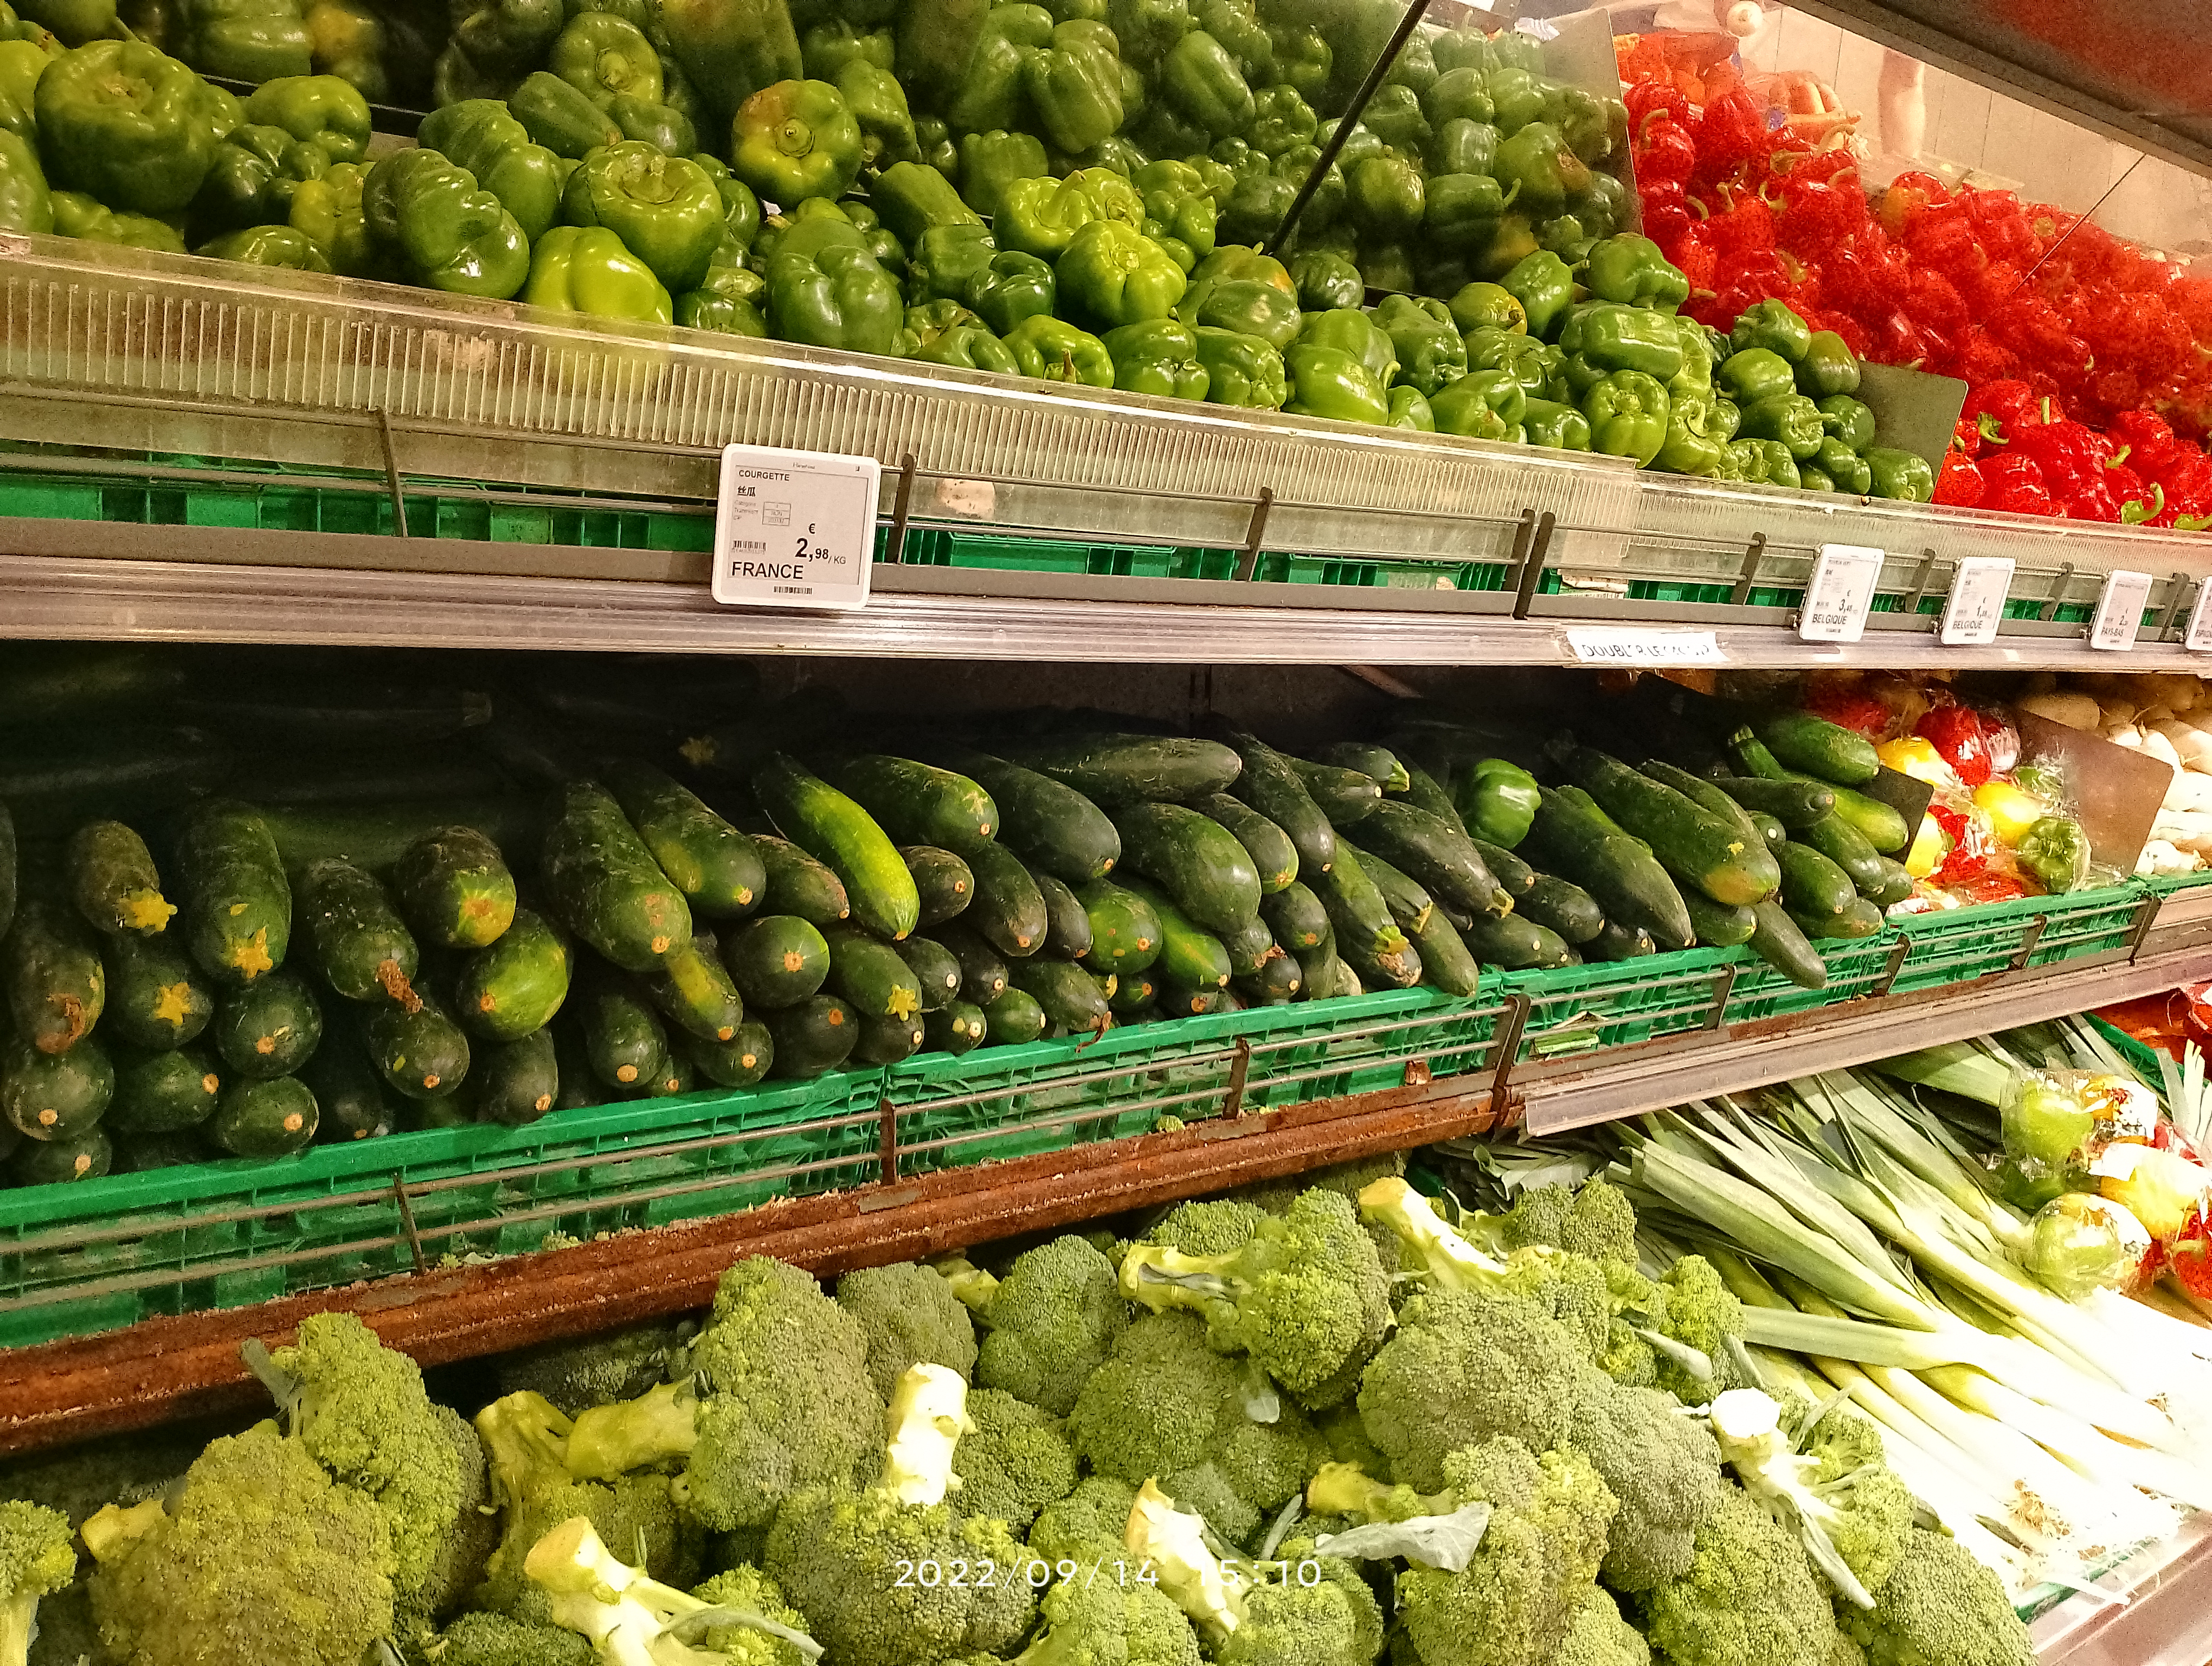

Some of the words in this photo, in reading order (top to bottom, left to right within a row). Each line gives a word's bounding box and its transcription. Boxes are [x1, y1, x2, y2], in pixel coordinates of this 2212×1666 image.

[738, 470, 790, 482] COURGETTE
[737, 485, 756, 497] 丝瓜
[808, 523, 816, 534] €
[731, 561, 804, 580] FRANCE
[1812, 614, 1848, 624] BELGIQUE
[1953, 620, 1983, 629] BELGIQUE
